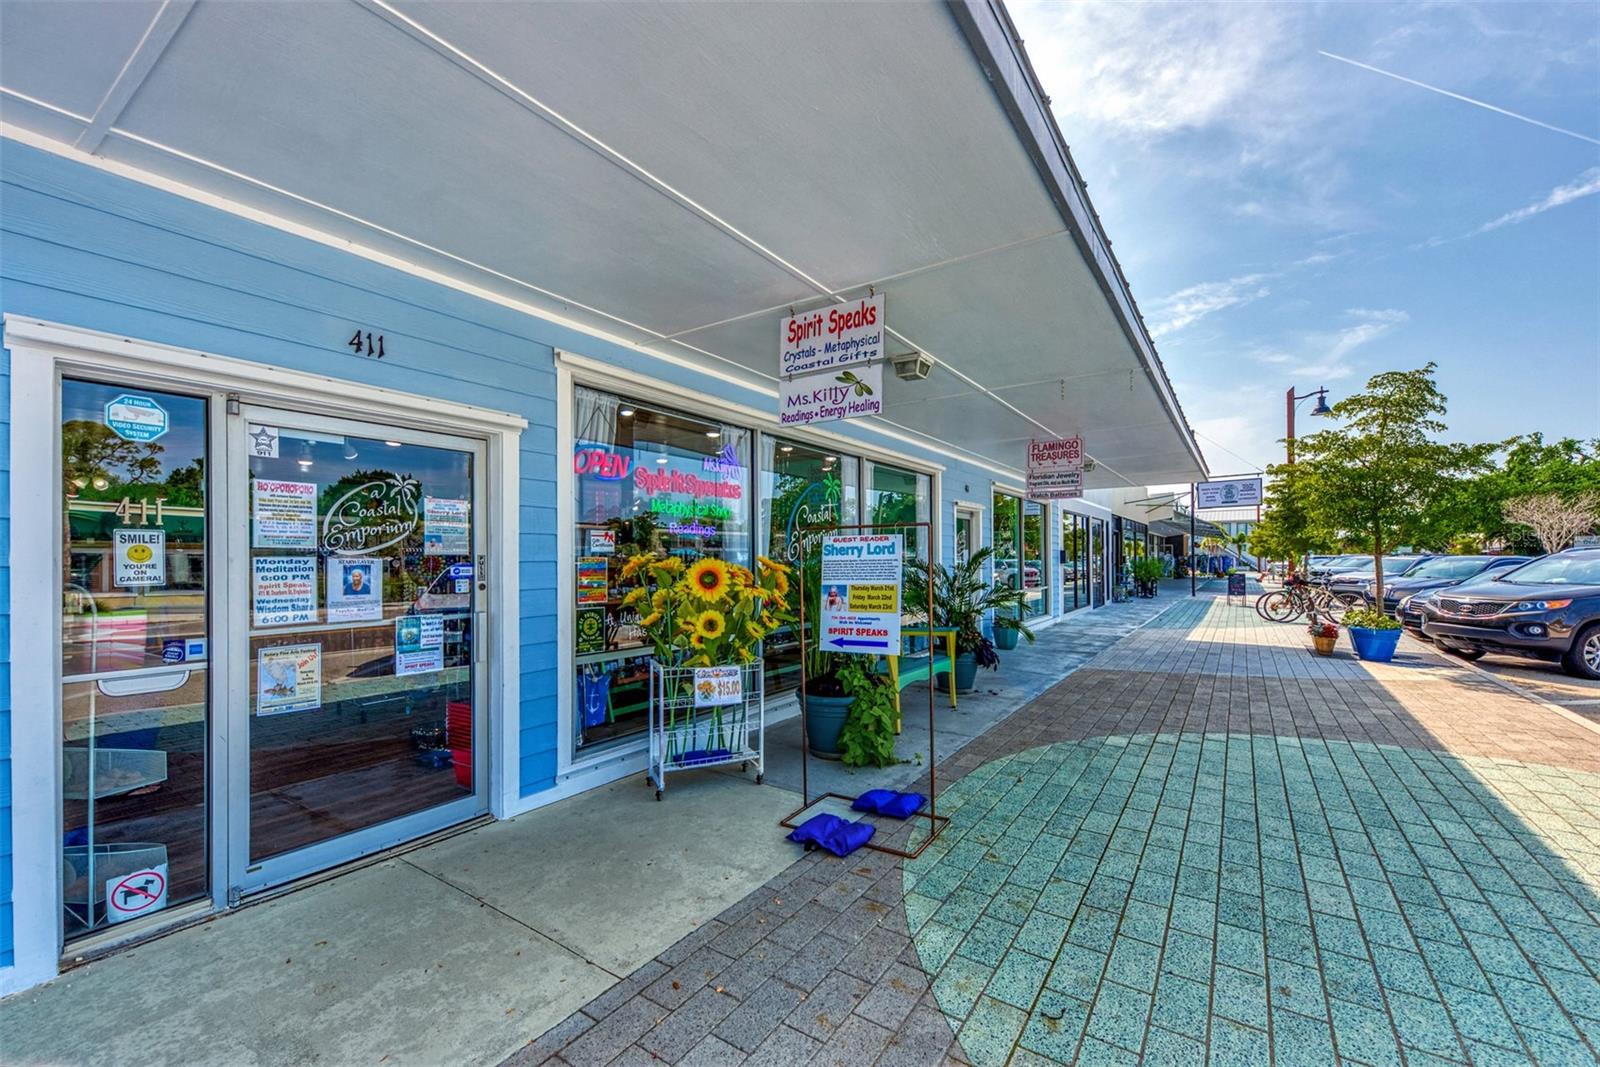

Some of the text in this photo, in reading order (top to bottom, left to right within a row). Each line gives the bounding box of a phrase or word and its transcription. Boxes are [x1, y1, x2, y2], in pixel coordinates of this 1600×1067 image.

[788, 301, 876, 349] Spirit Speaks
[348, 329, 385, 359] 411
[784, 346, 816, 363] Crystals
[824, 331, 880, 354] Metaphysical
[785, 349, 877, 373] Coastal Gifts
[781, 399, 880, 424] Readings Energy Healing
[112, 421, 131, 429] VIDEO
[1031, 450, 1080, 461] TREASURES
[1032, 440, 1079, 453] FLAMINGO
[574, 450, 630, 479] OPEN
[116, 497, 164, 525] 411
[339, 495, 401, 526] Coastal
[796, 498, 839, 533] Coastal
[325, 521, 413, 550] Emporium
[668, 520, 716, 538] Readings
[120, 534, 160, 544] SMILE!
[824, 542, 895, 558] Sherry Lord
[256, 605, 289, 613] Wisdom
[262, 615, 288, 624] 6:00
[828, 627, 888, 637] SPIRIT SPEAKS
[297, 658, 310, 669] Join
[717, 680, 740, 697] $15.00
